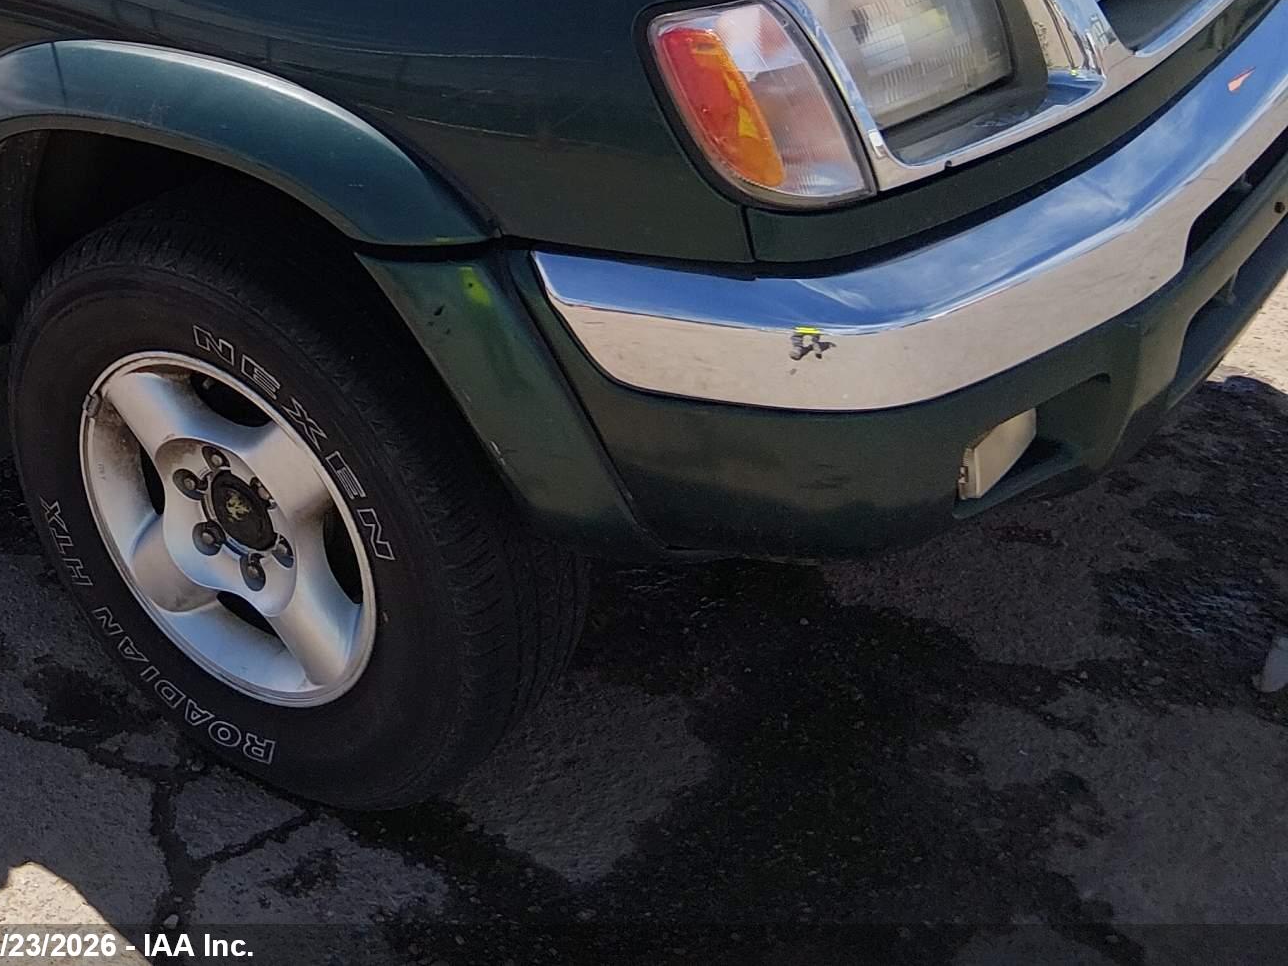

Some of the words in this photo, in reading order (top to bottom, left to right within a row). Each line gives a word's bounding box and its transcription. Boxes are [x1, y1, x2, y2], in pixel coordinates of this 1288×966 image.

[192, 324, 396, 561] NEXEN
[39, 497, 93, 587] HTX
[91, 606, 276, 765] ROADIAN
